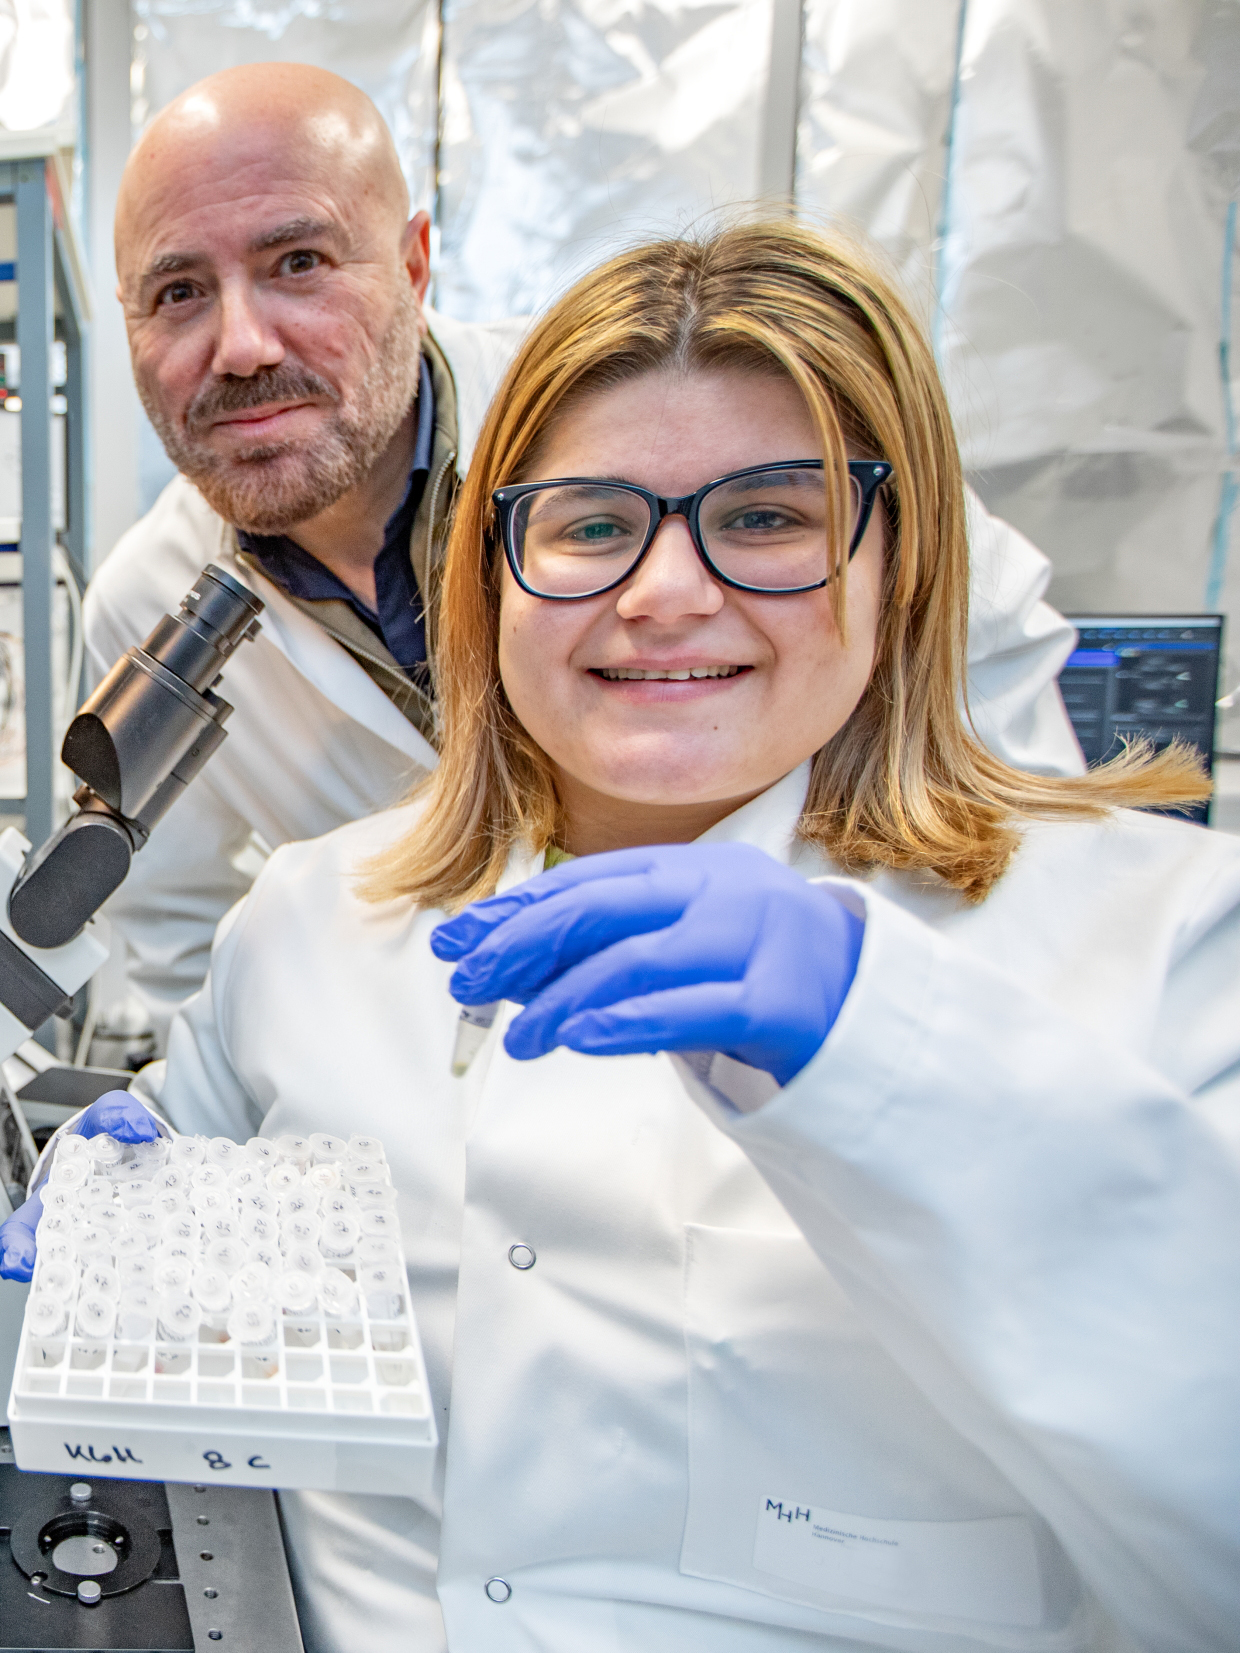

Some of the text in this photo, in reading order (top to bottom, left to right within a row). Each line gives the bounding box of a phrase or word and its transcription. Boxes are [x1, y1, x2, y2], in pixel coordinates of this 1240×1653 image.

[202, 1449, 232, 1470] 8
[765, 1498, 811, 1523] MHH
[811, 1530, 845, 1545] Hannover
[813, 1524, 899, 1547] Medizinische Hochschule
